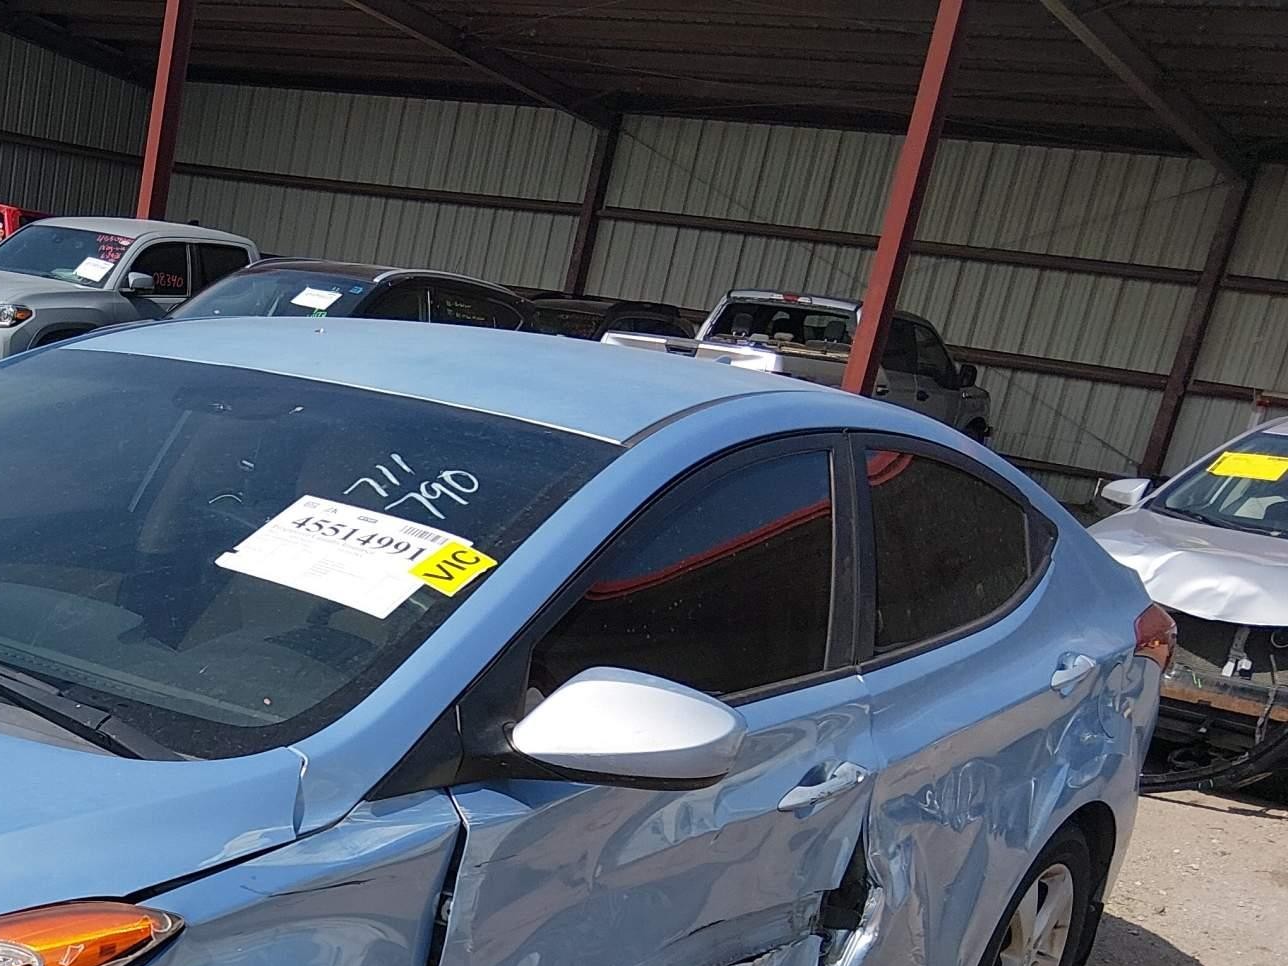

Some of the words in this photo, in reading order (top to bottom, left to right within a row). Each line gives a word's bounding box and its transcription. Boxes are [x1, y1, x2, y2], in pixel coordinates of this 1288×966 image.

[343, 453, 415, 498] 711
[384, 470, 479, 520] 790
[292, 516, 427, 561] 45514991
[422, 550, 481, 582] VIC
